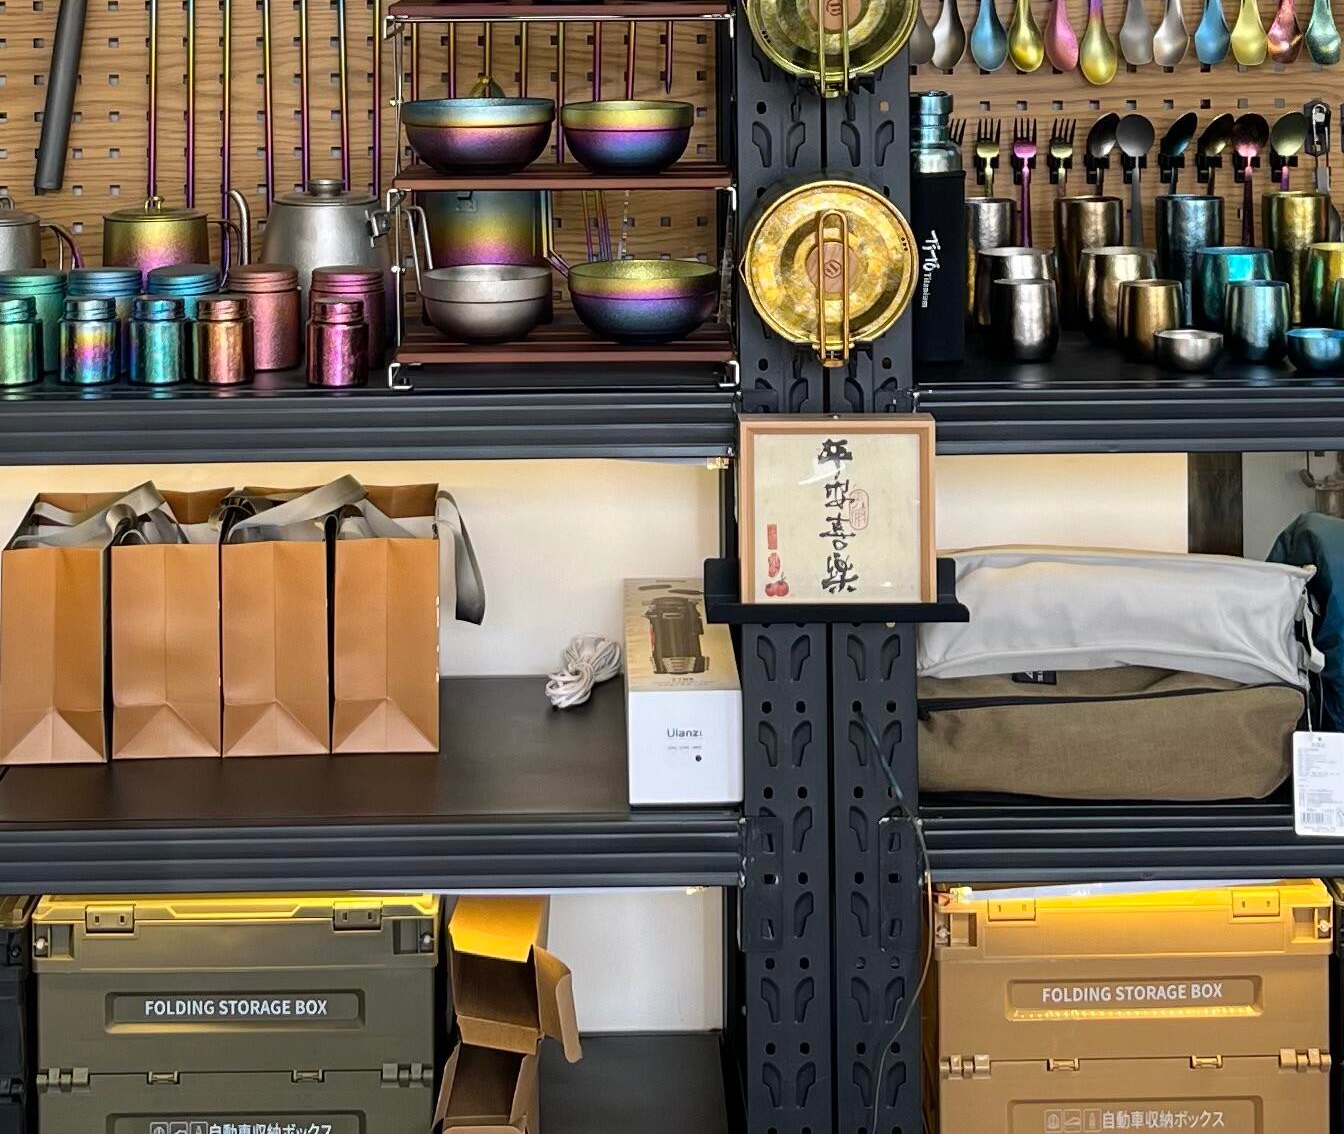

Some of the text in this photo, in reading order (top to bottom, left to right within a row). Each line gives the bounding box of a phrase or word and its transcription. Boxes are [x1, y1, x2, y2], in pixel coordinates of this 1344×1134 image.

[666, 727, 704, 738] Ulanzi
[1042, 983, 1223, 1003] FOLDING STORAGE BOX
[145, 999, 328, 1016] FOLDING STORAGE BOX
